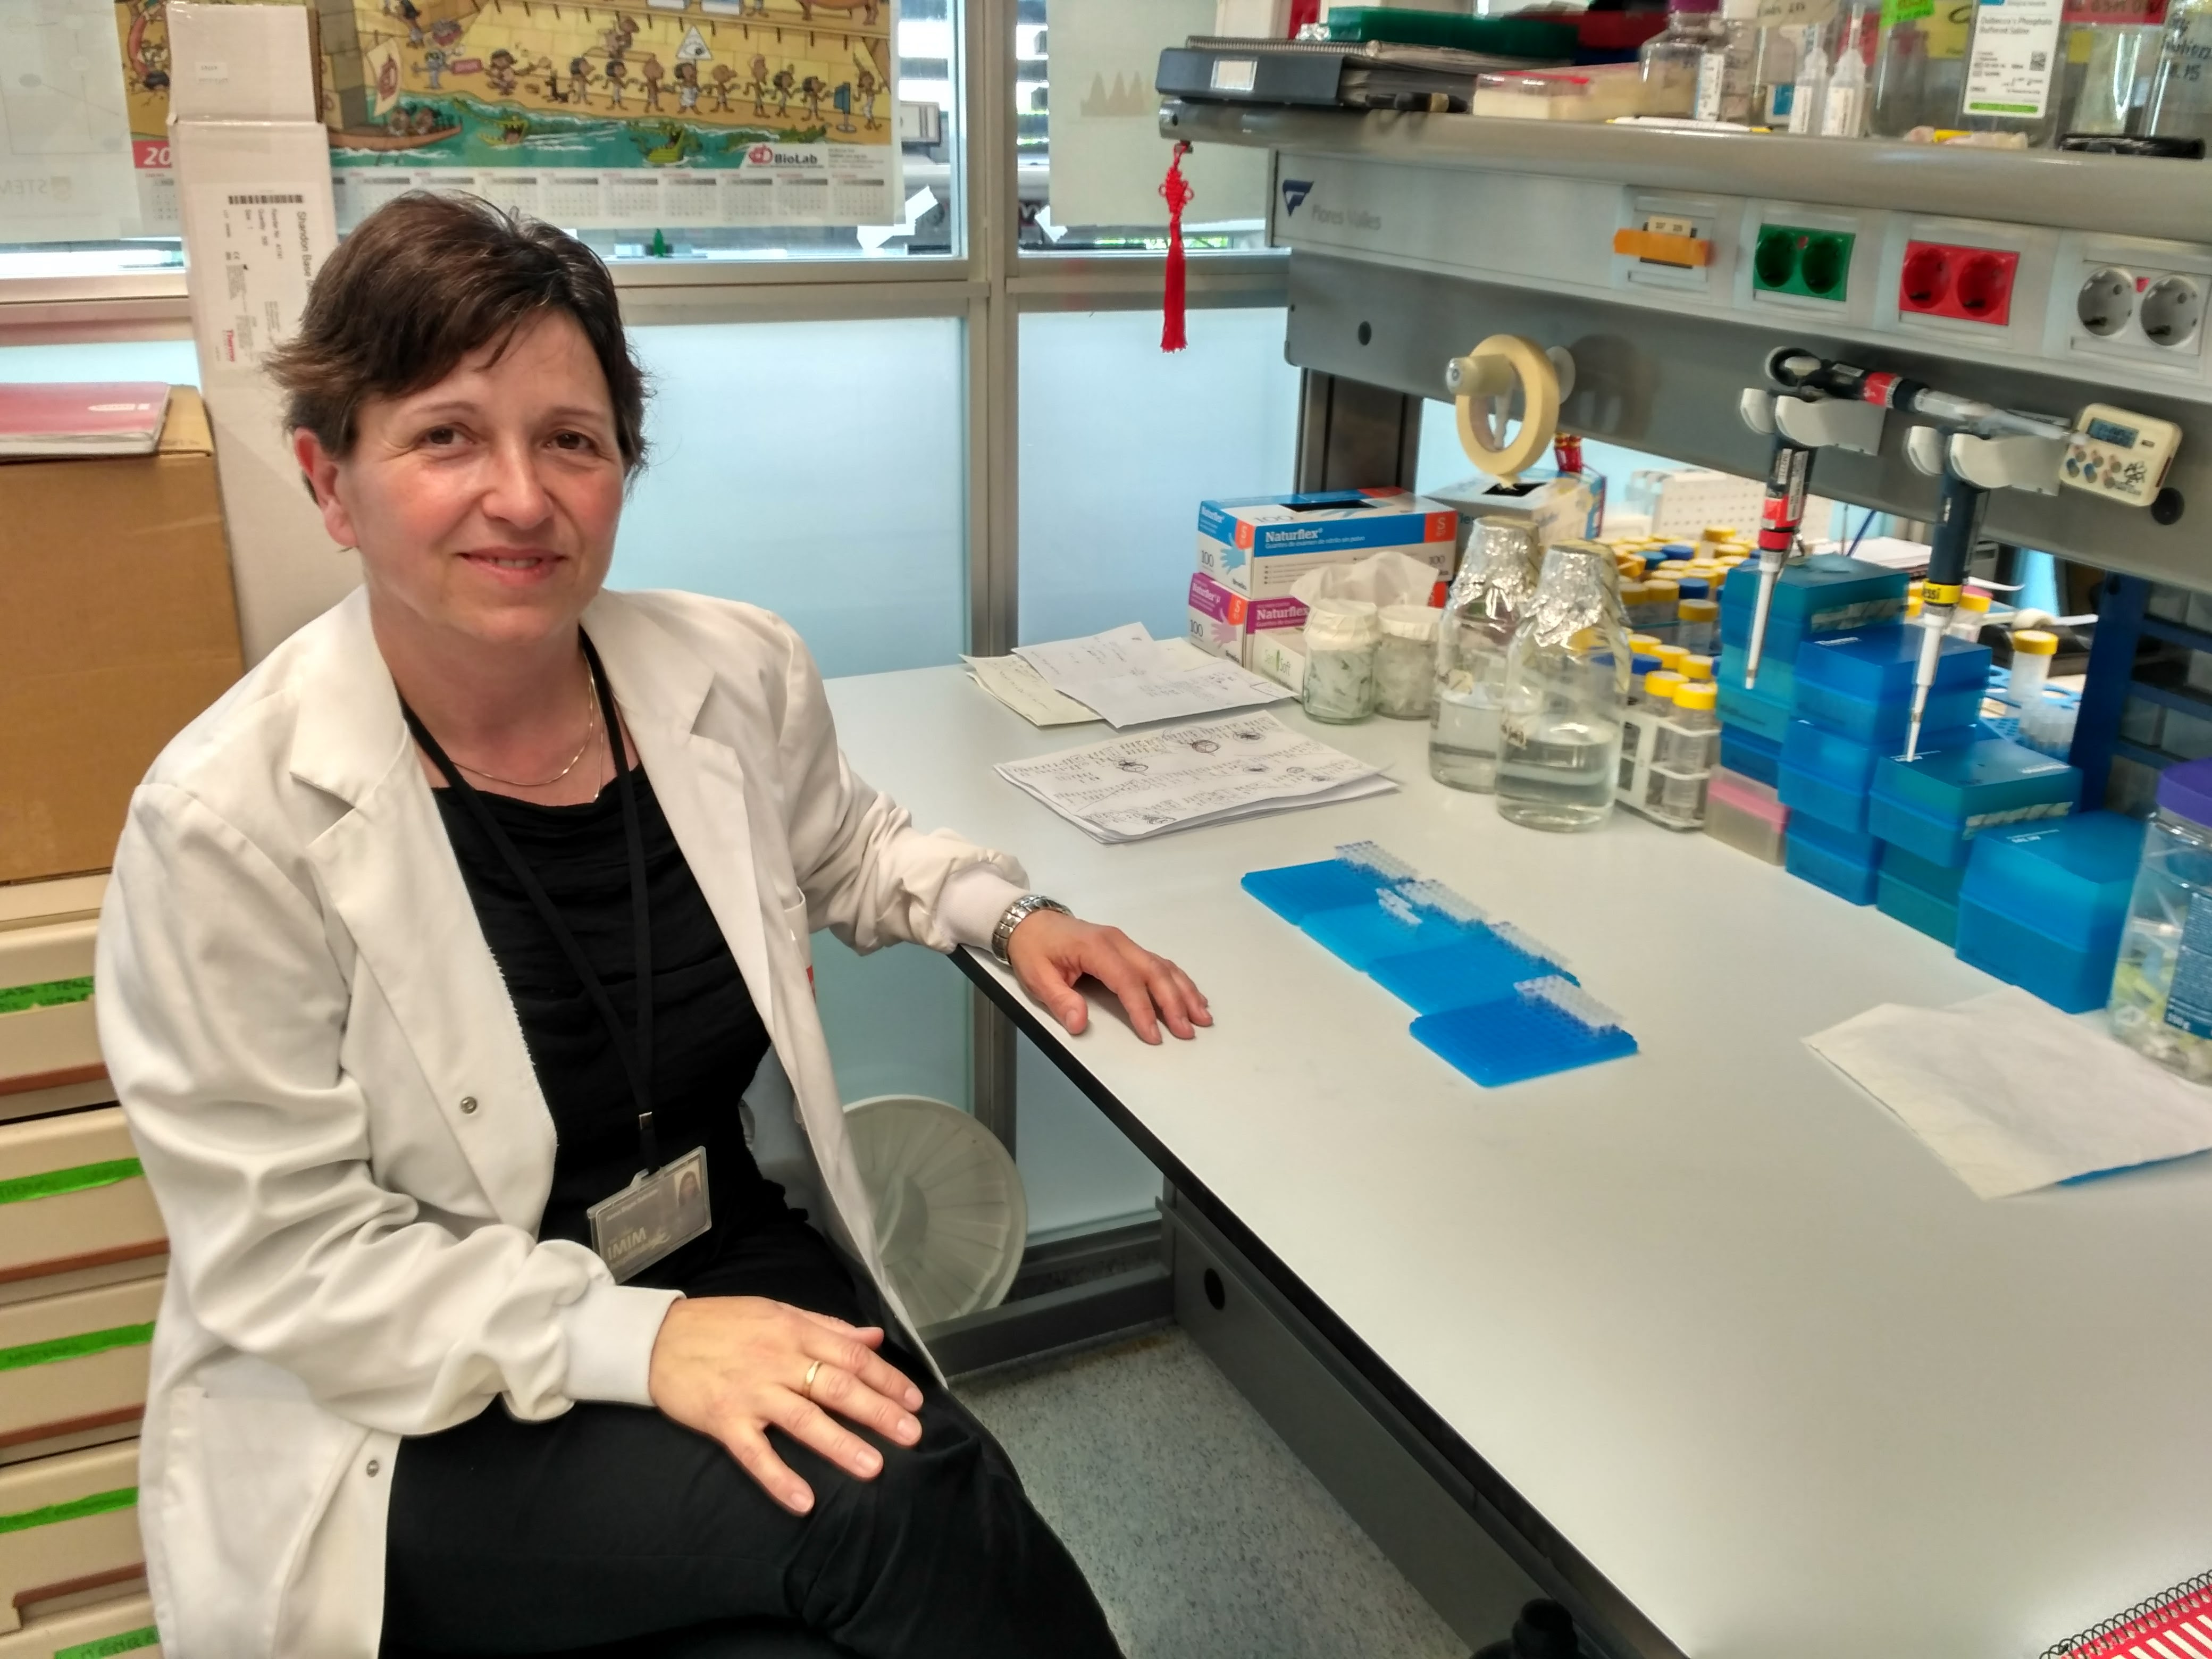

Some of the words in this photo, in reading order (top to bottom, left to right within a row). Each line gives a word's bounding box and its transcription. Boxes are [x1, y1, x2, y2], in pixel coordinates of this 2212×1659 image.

[774, 153, 818, 164] BioLab
[296, 211, 308, 253] Shandon
[301, 254, 313, 278] Base
[1253, 514, 1294, 523] 100
[1437, 516, 1446, 530] S
[1201, 550, 1214, 567] 100
[1189, 619, 1203, 638] 100
[1279, 657, 1292, 676] Soft
[608, 1226, 647, 1261] IMIM
